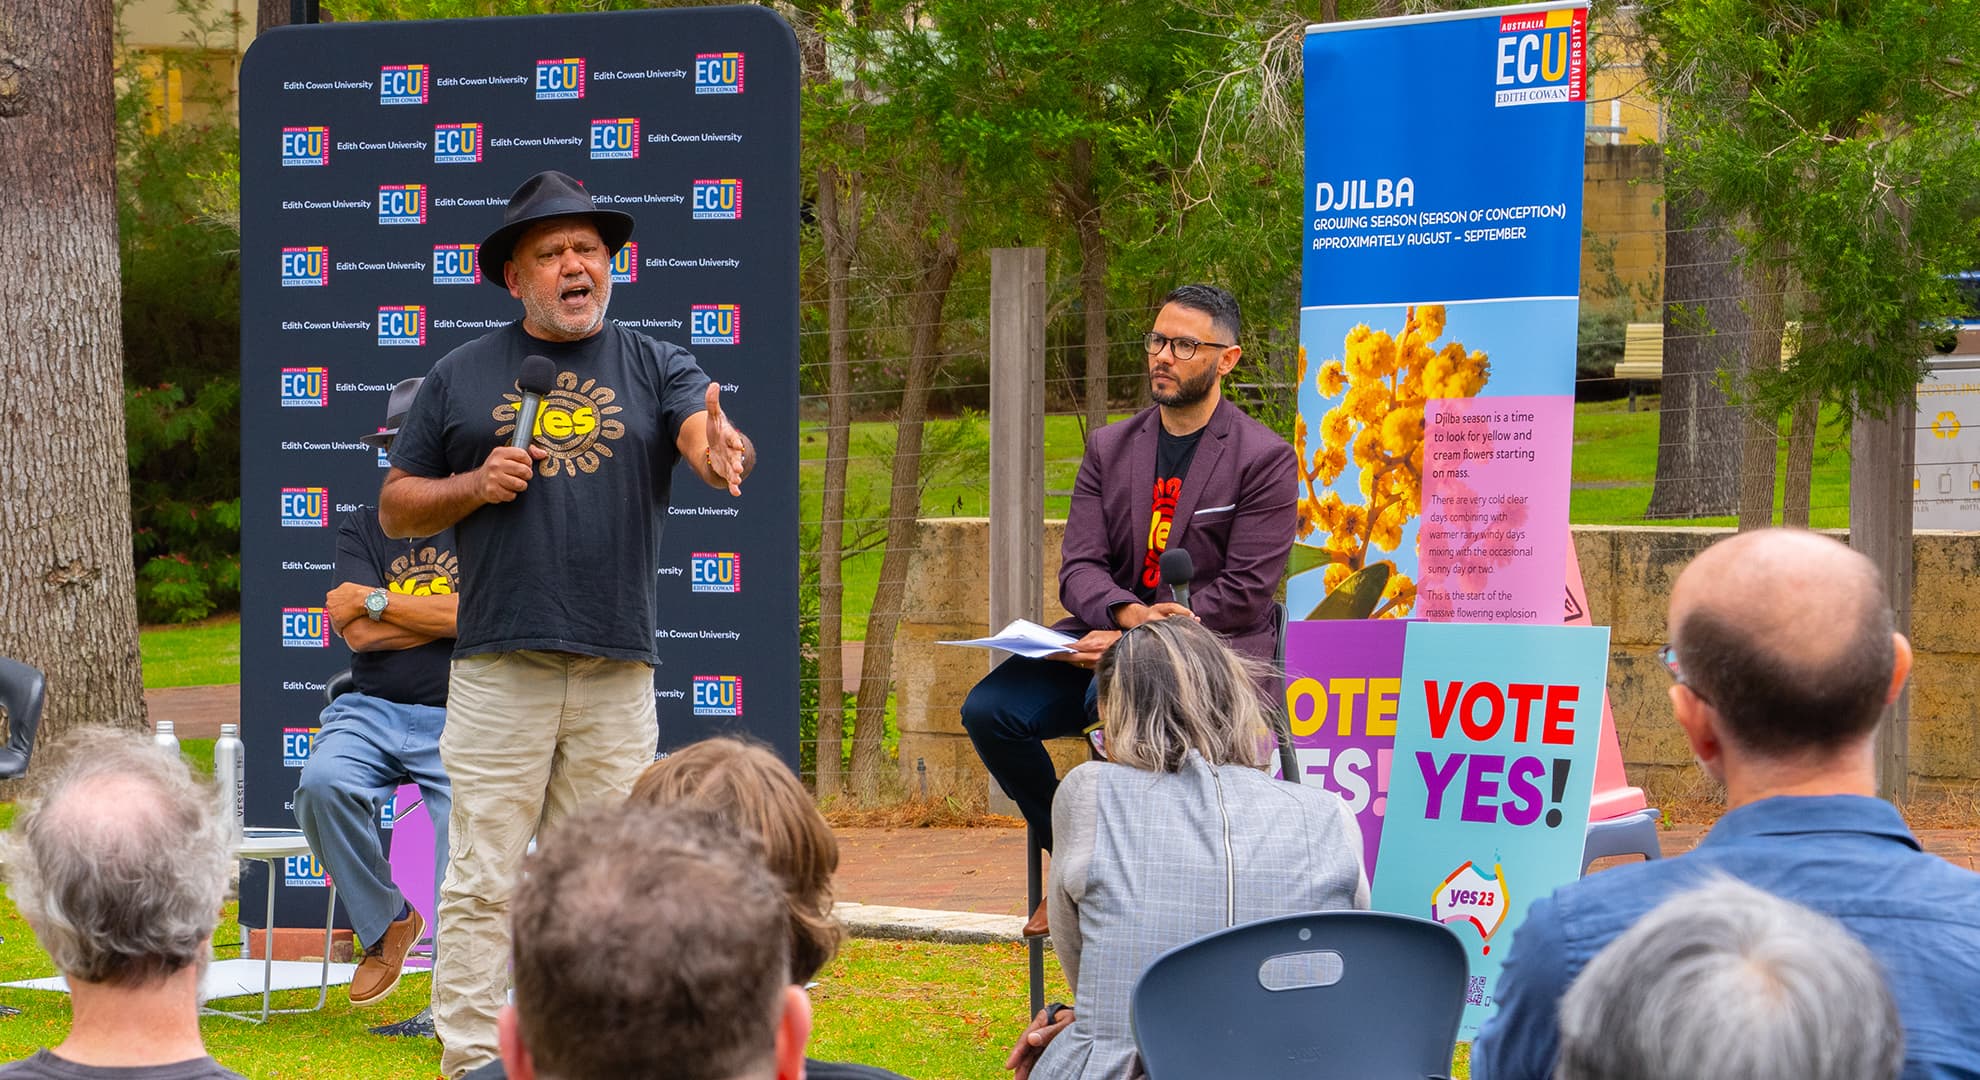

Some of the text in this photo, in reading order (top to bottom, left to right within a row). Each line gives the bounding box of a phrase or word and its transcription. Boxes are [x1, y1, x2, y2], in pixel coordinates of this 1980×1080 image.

[1501, 19, 1545, 32] AUSTRALIA
[1496, 31, 1568, 85] ECU
[1570, 19, 1582, 98] UNIVERSITY
[536, 65, 577, 90] ECU
[593, 68, 687, 81] Edith Cowan University
[696, 60, 736, 84] ECU
[283, 79, 374, 90] Edith Cowan University
[381, 72, 421, 95] ECU
[436, 75, 529, 87] Edith Cowan University
[1497, 88, 1568, 104] EDITH COWAN
[435, 130, 475, 153] ECU
[490, 136, 584, 147] Edith Cowan University
[591, 125, 631, 149] ECU
[647, 132, 743, 143] Edith Cowan University
[282, 133, 321, 156] ECU
[336, 140, 428, 151] Edith Cowan University
[591, 193, 685, 205] Edith Cowan University
[693, 186, 733, 209] ECU
[1315, 177, 1415, 212] DJILBA
[282, 199, 372, 210] Edith Cowan University
[379, 192, 418, 215] ECU
[434, 198, 457, 207] Edith
[456, 197, 486, 207] Cowan
[1313, 203, 1567, 232] GROWING SEASON (SEASON OF CONCEPTION)
[1312, 234, 1405, 251] APPROXIMATELY
[1407, 231, 1452, 246] AUGUST
[1463, 226, 1527, 243] SEPTEMBER
[282, 253, 321, 276] ECU
[336, 260, 426, 272] Edith Cowan University
[433, 250, 473, 274] ECU
[645, 257, 740, 269] Edith Cowan University
[281, 320, 371, 331] Edith Cowan University
[378, 312, 418, 336] ECU
[433, 319, 455, 329] Edith
[455, 319, 485, 328] Cowan
[611, 318, 683, 329] Cowan University
[692, 311, 732, 335] ECU
[281, 374, 321, 397] ECU
[335, 383, 357, 392] Edith
[357, 382, 386, 392] Cowan
[719, 382, 740, 394] rsity
[511, 400, 596, 437] Yes
[1435, 410, 1535, 427] Djilba season is a time
[1434, 429, 1532, 444] to look for yellow and
[281, 441, 371, 452] Edith Cowan University
[1433, 448, 1536, 462] cream flowers starting
[1432, 469, 1470, 478] on mass.
[281, 494, 321, 517] ECU
[1432, 494, 1528, 507] There are very cold clear
[335, 503, 358, 513] Edith
[667, 506, 740, 518] Cowan University
[1430, 512, 1508, 524] days combining with
[1429, 531, 1458, 540] warmer
[1480, 529, 1504, 542] windy
[1506, 529, 1526, 542] days
[1428, 547, 1533, 559] mixing with the occasional
[281, 561, 304, 570] Edith
[303, 561, 332, 571] Cowan
[692, 559, 732, 582] ECU
[1428, 565, 1451, 577] sunny
[1452, 565, 1465, 577] day
[1468, 565, 1477, 574] or
[1427, 589, 1513, 601] This is the start of the
[1425, 608, 1537, 621] massive flowering explosion
[283, 614, 321, 638] ECU
[669, 629, 699, 639] Cowan
[699, 630, 741, 641] University
[282, 681, 305, 691] Edith
[655, 688, 685, 699] iversity
[693, 682, 734, 706] ECU
[1286, 677, 1401, 737] OTE
[1424, 680, 1581, 745] VOTE
[1414, 751, 1573, 829] YES!
[285, 855, 324, 877] ECU
[1448, 885, 1495, 908] yes23
